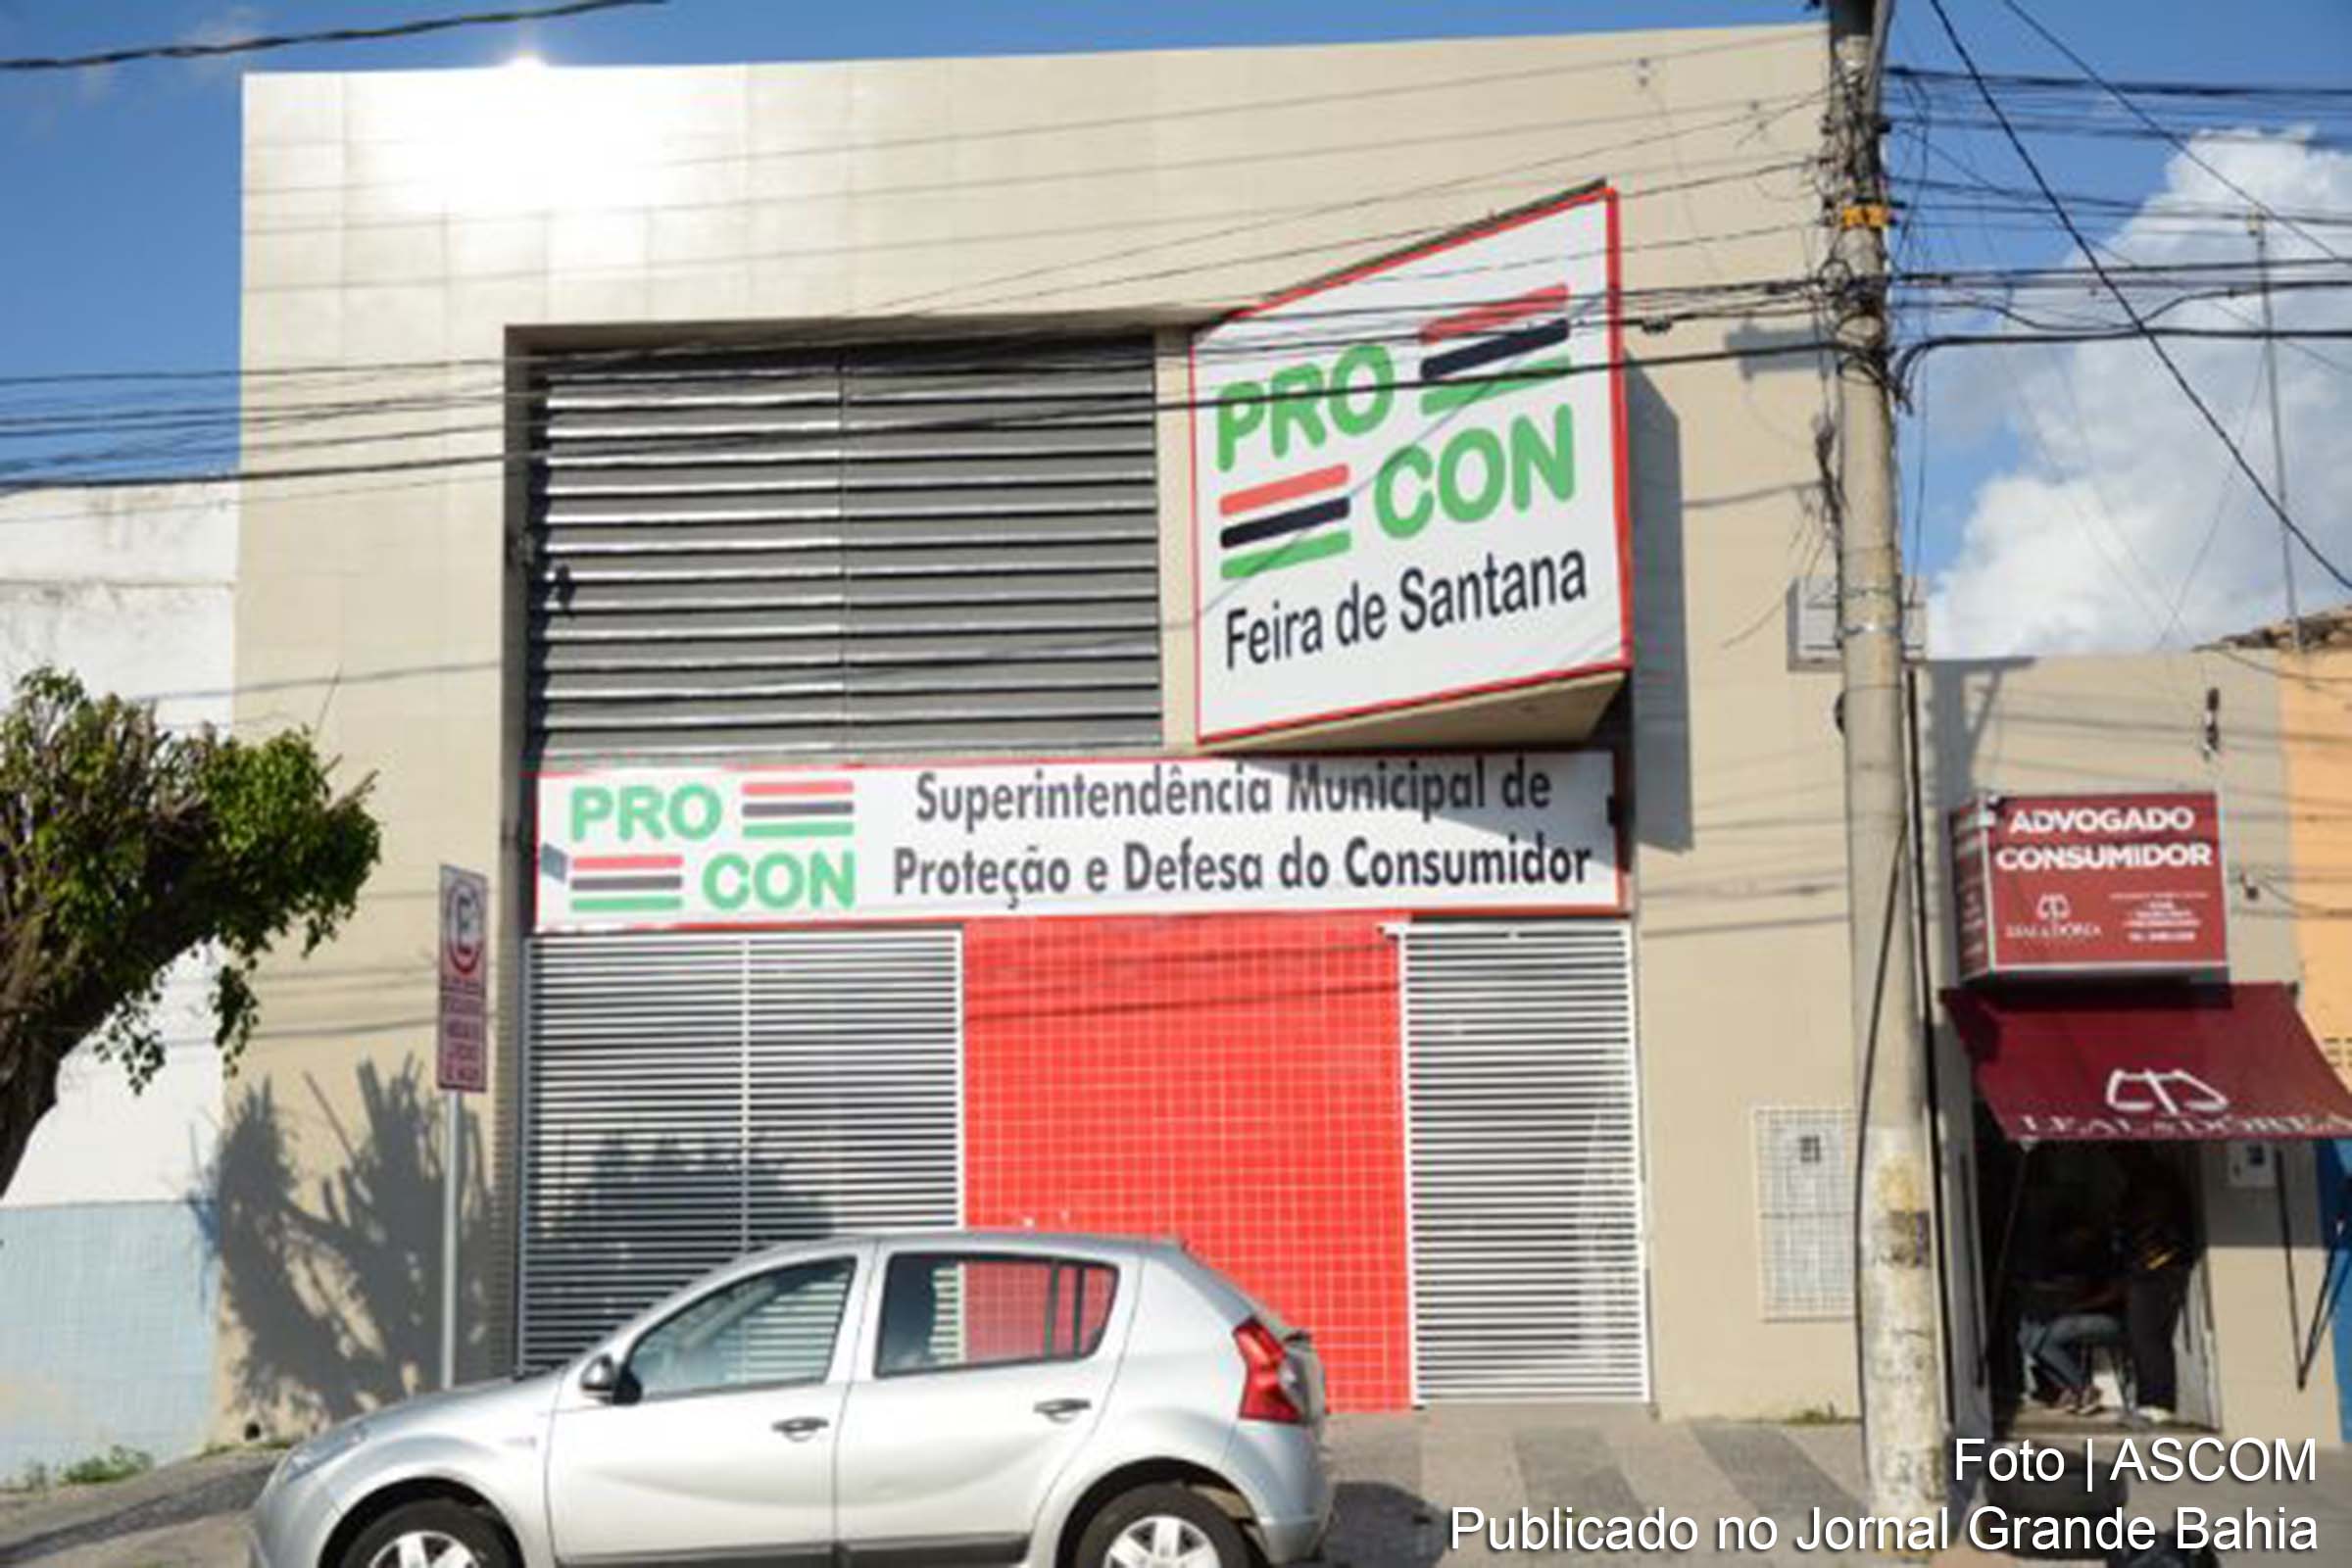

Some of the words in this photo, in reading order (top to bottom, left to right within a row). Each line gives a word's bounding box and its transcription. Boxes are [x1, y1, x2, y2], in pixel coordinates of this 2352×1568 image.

[1215, 343, 1394, 471] PRO
[1375, 404, 1574, 538] CON
[1226, 601, 1323, 670] Feira
[1337, 581, 1387, 648] de
[1399, 549, 1587, 633] Santana
[570, 784, 723, 843] PRO
[916, 763, 1271, 832] Superintendência
[1288, 760, 1487, 821] Municipal
[1501, 758, 1551, 808] de
[2009, 807, 2195, 834] ADVOGADO
[702, 851, 856, 909] CON
[894, 847, 1069, 907] Proteção
[1086, 856, 1108, 891] e
[1124, 837, 1263, 891] Defesa
[1278, 837, 1328, 888] do
[1345, 830, 1593, 887] Consumidor
[1995, 843, 2213, 870] CONSUMIDOR
